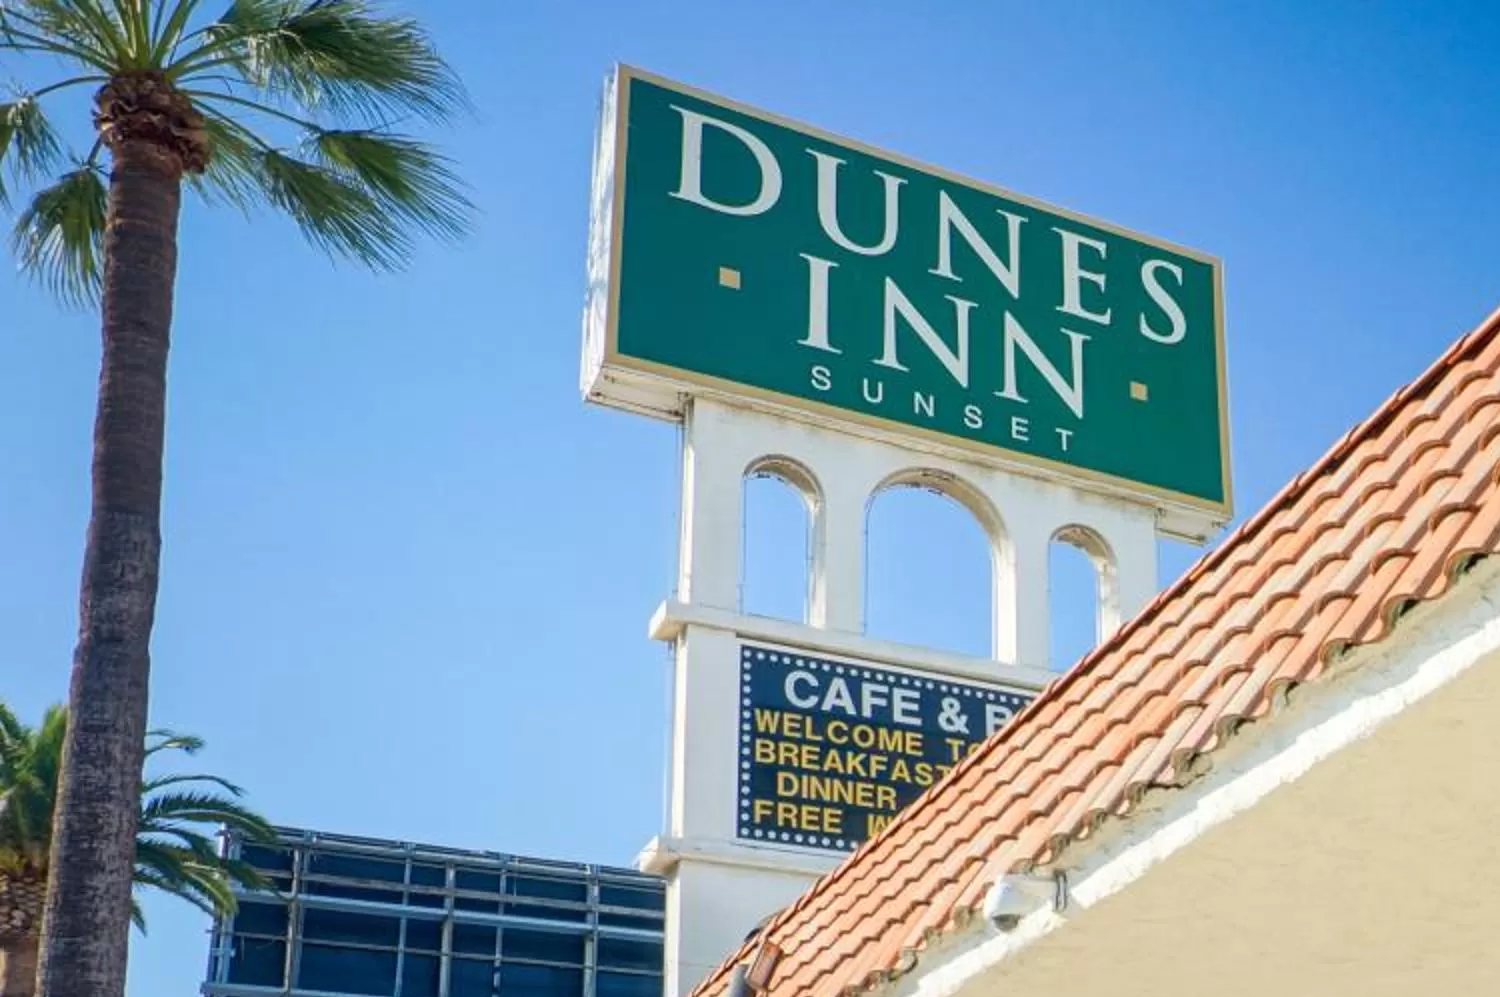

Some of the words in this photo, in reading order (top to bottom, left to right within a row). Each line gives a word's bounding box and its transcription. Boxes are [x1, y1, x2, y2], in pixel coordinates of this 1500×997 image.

[668, 104, 1186, 345] DUNES
[797, 253, 1091, 419] INN
[811, 366, 1074, 452] SUNSET
[754, 708, 924, 757] WELCOME
[784, 670, 922, 725] CAFE
[937, 697, 970, 735] &
[753, 800, 843, 834] FREE
[777, 771, 897, 810] DINNER
